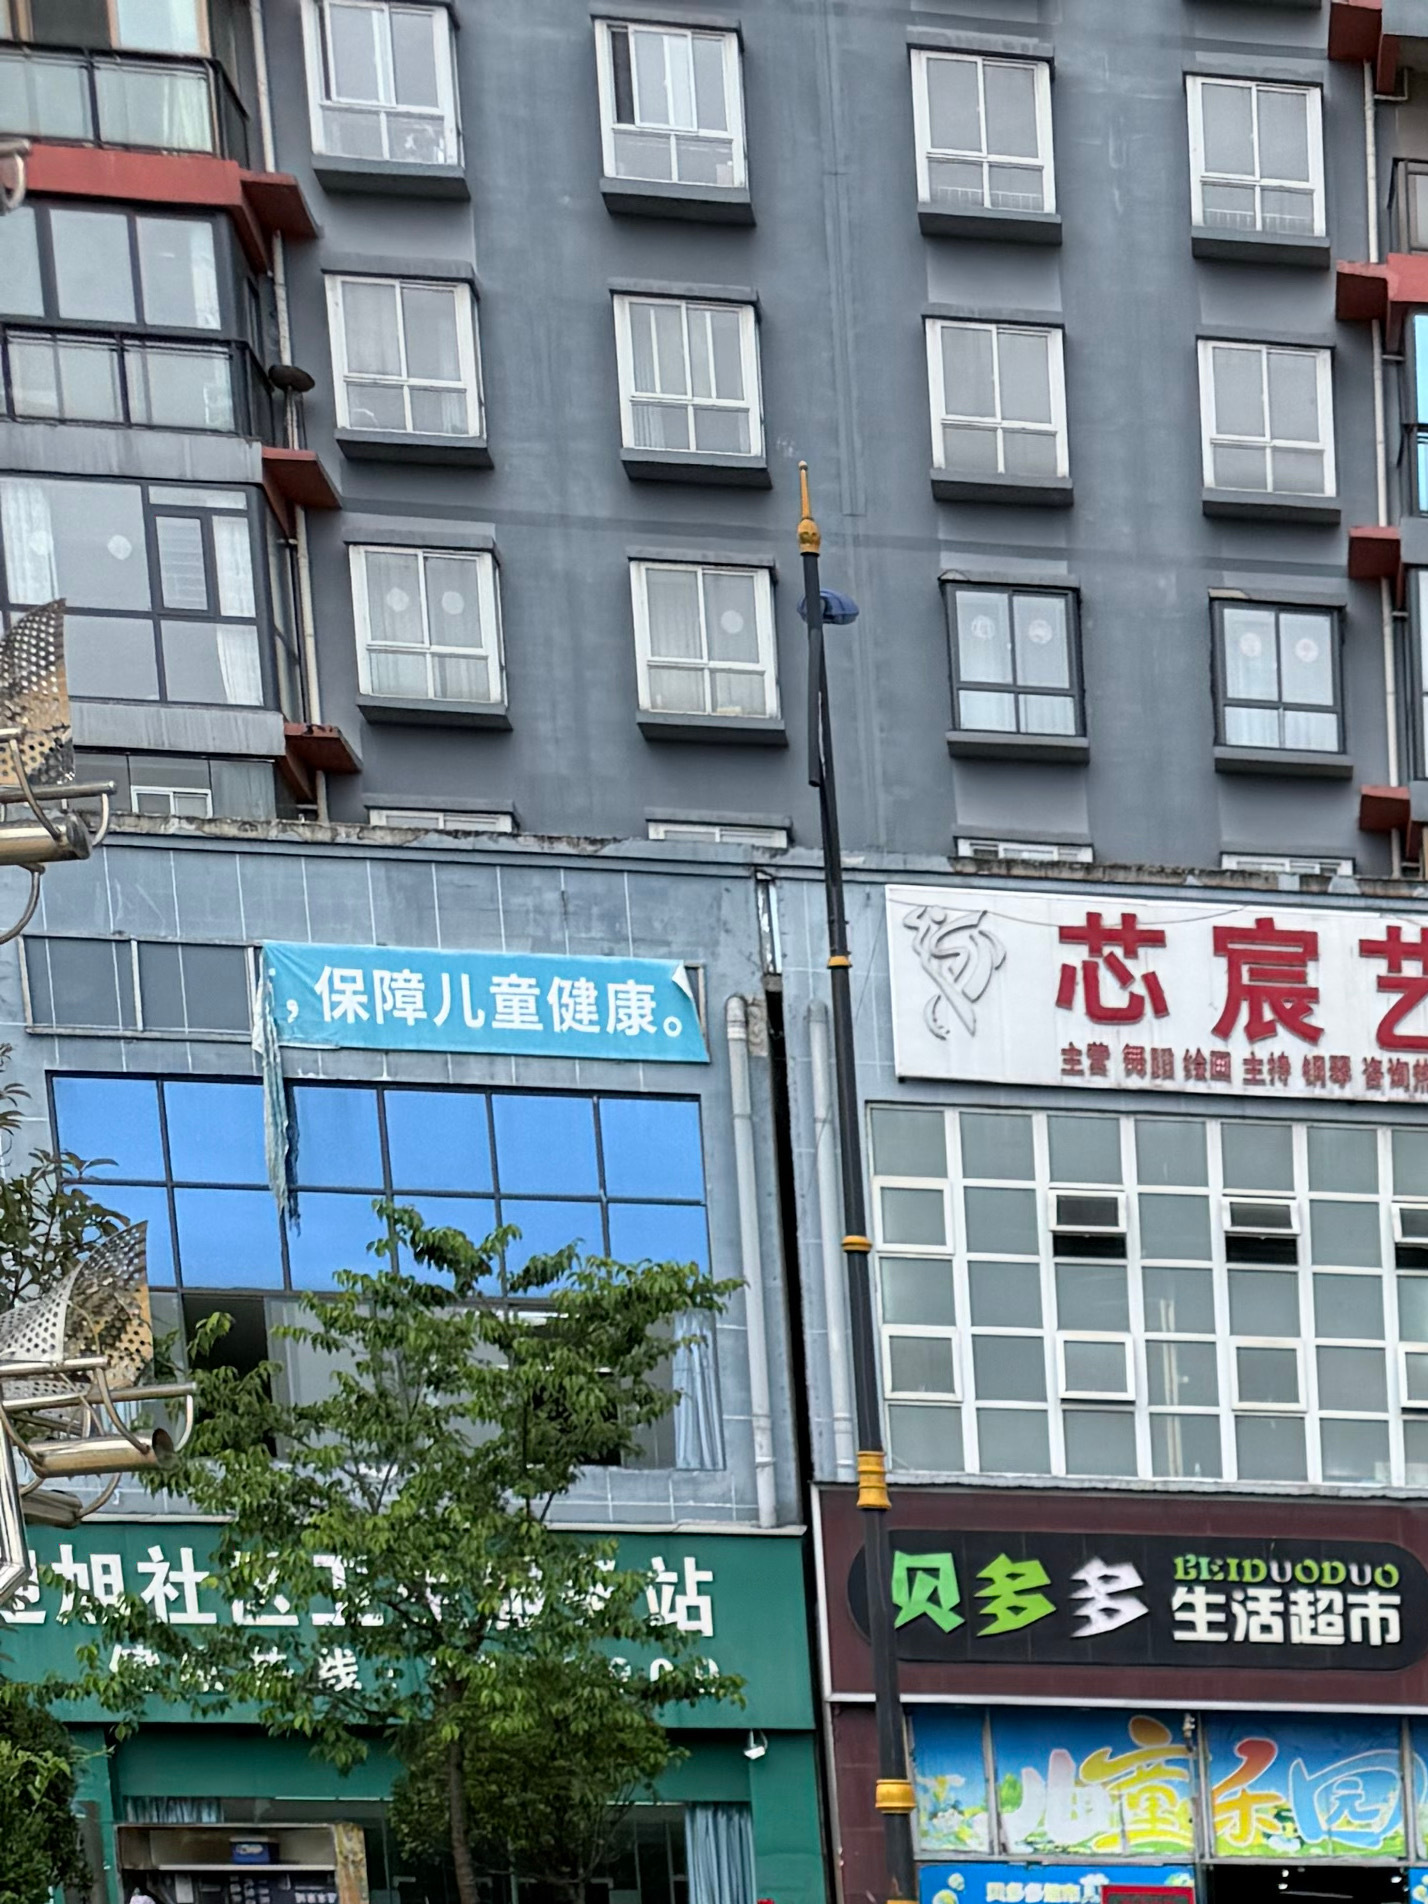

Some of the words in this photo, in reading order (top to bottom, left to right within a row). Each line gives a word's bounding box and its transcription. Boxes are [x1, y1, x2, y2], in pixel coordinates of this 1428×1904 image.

[1060, 1042, 1110, 1077] 主营
[1183, 1048, 1231, 1083] 绘画
[1242, 1051, 1291, 1086] 主持
[891, 1551, 1149, 1639] 贝多多
[1173, 1554, 1399, 1588] BEIDUODUO
[1172, 1586, 1400, 1646] 生活超市
[1001, 1714, 1427, 1853] 儿童乐园
